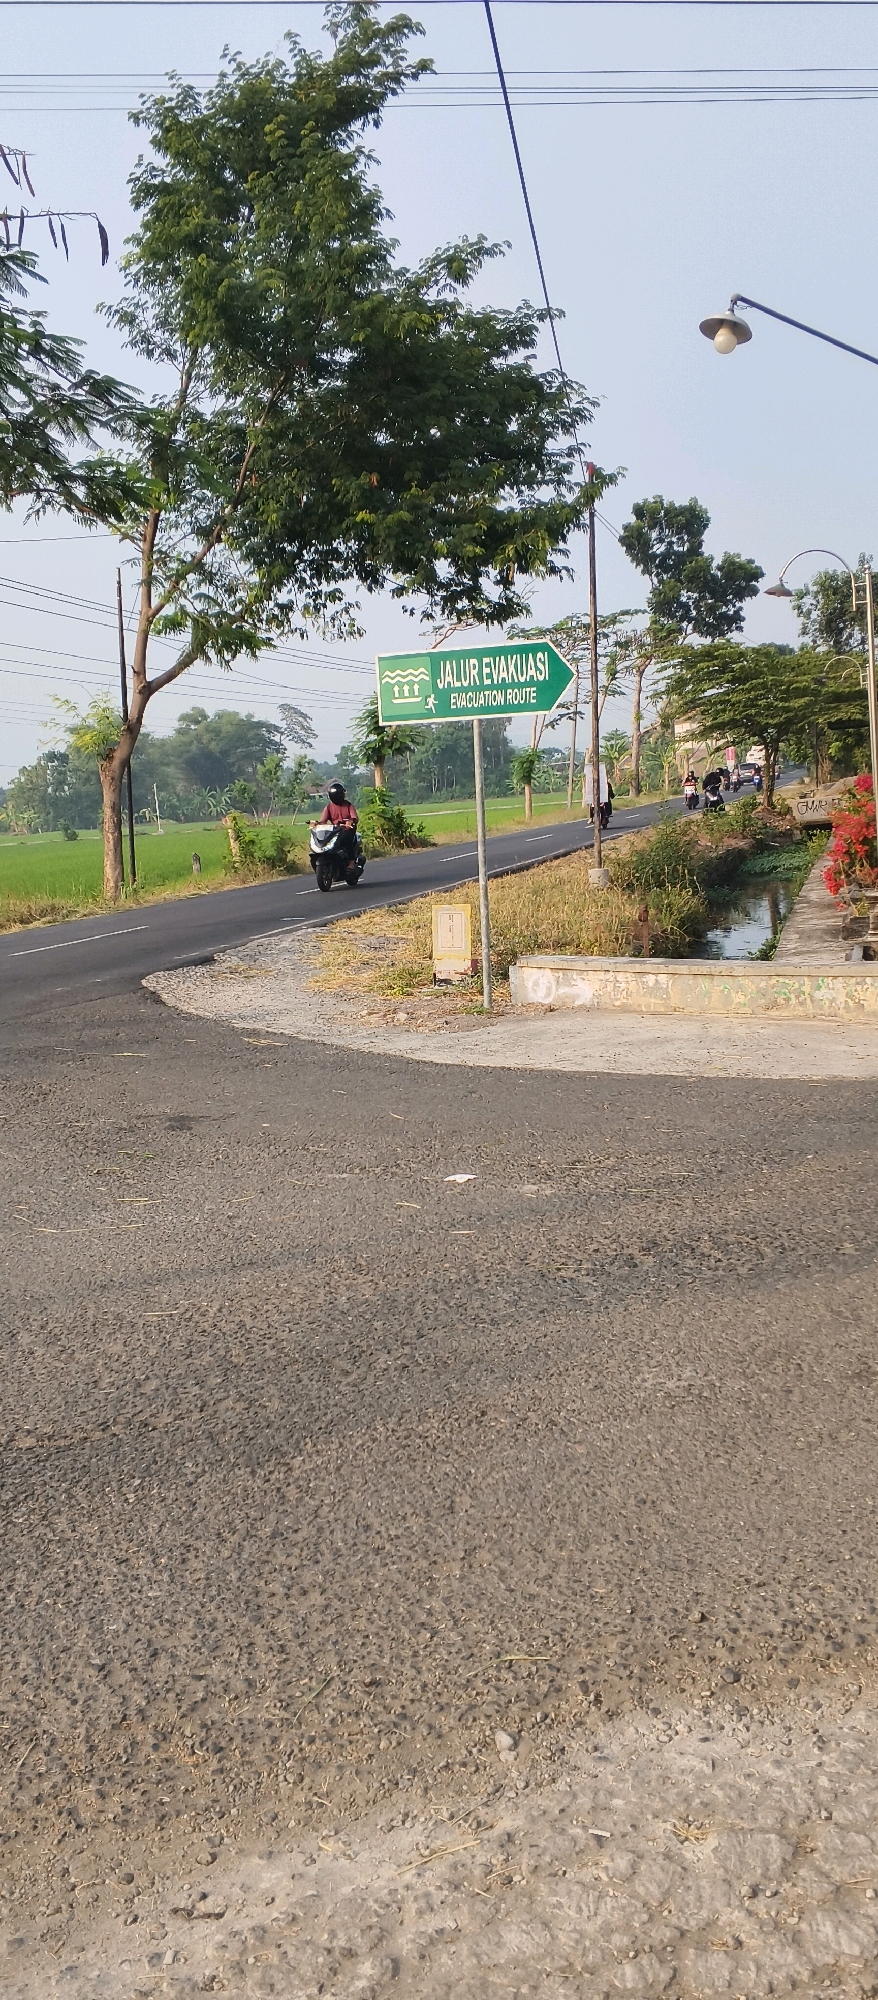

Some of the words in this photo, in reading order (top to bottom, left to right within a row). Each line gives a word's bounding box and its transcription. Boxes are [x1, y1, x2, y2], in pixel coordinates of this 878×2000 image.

[437, 658, 480, 689] JALUR
[483, 651, 549, 685] EVAKUASI
[450, 690, 505, 709] EVACUATION
[506, 687, 537, 705] ROUTE
